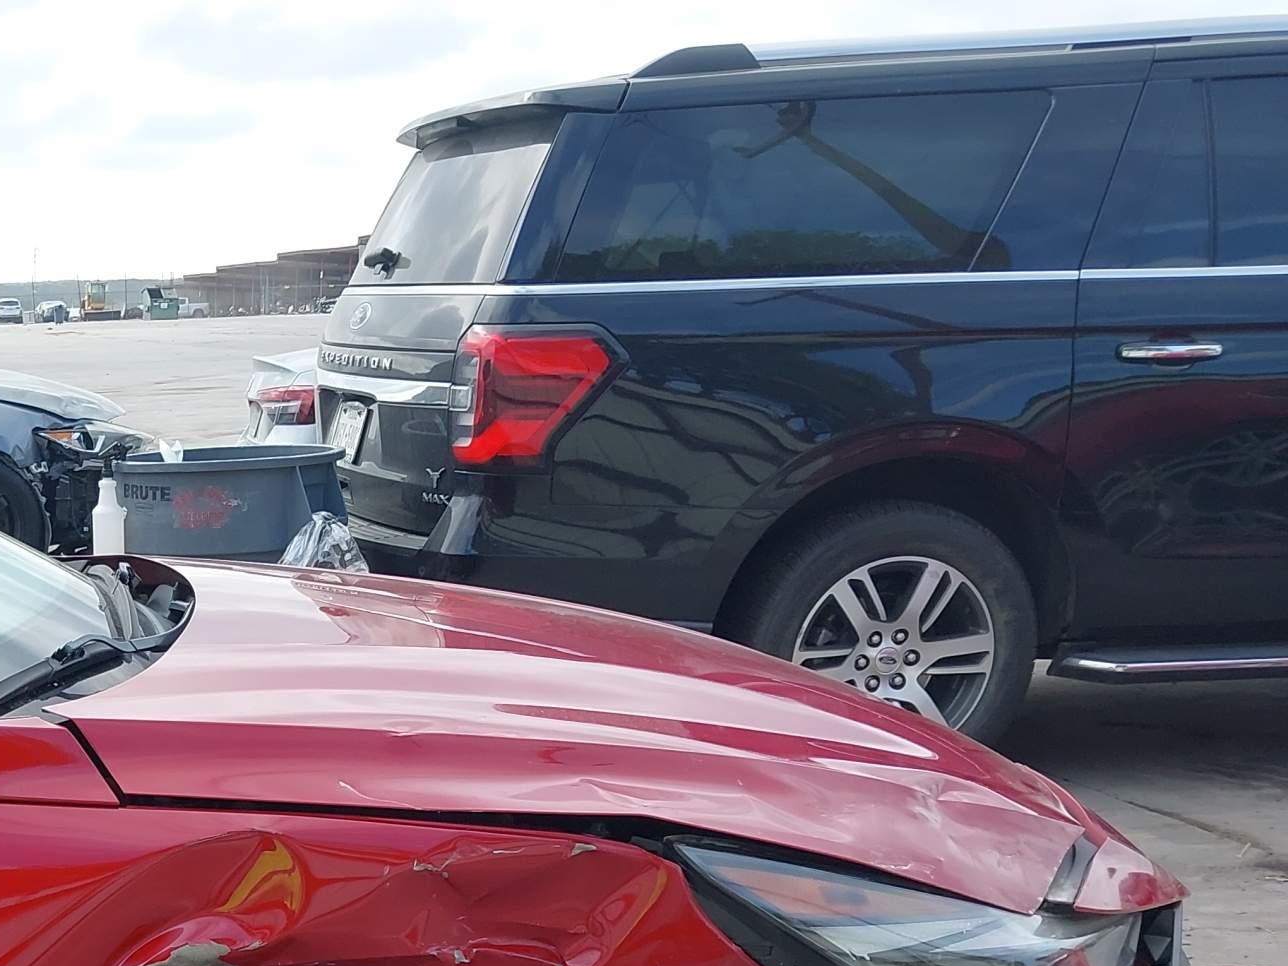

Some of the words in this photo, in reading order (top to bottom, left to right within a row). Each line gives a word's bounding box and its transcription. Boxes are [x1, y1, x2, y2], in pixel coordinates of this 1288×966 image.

[321, 350, 392, 370] EXPEDITION
[123, 483, 173, 502] BRUTE
[422, 491, 450, 505] MAX
